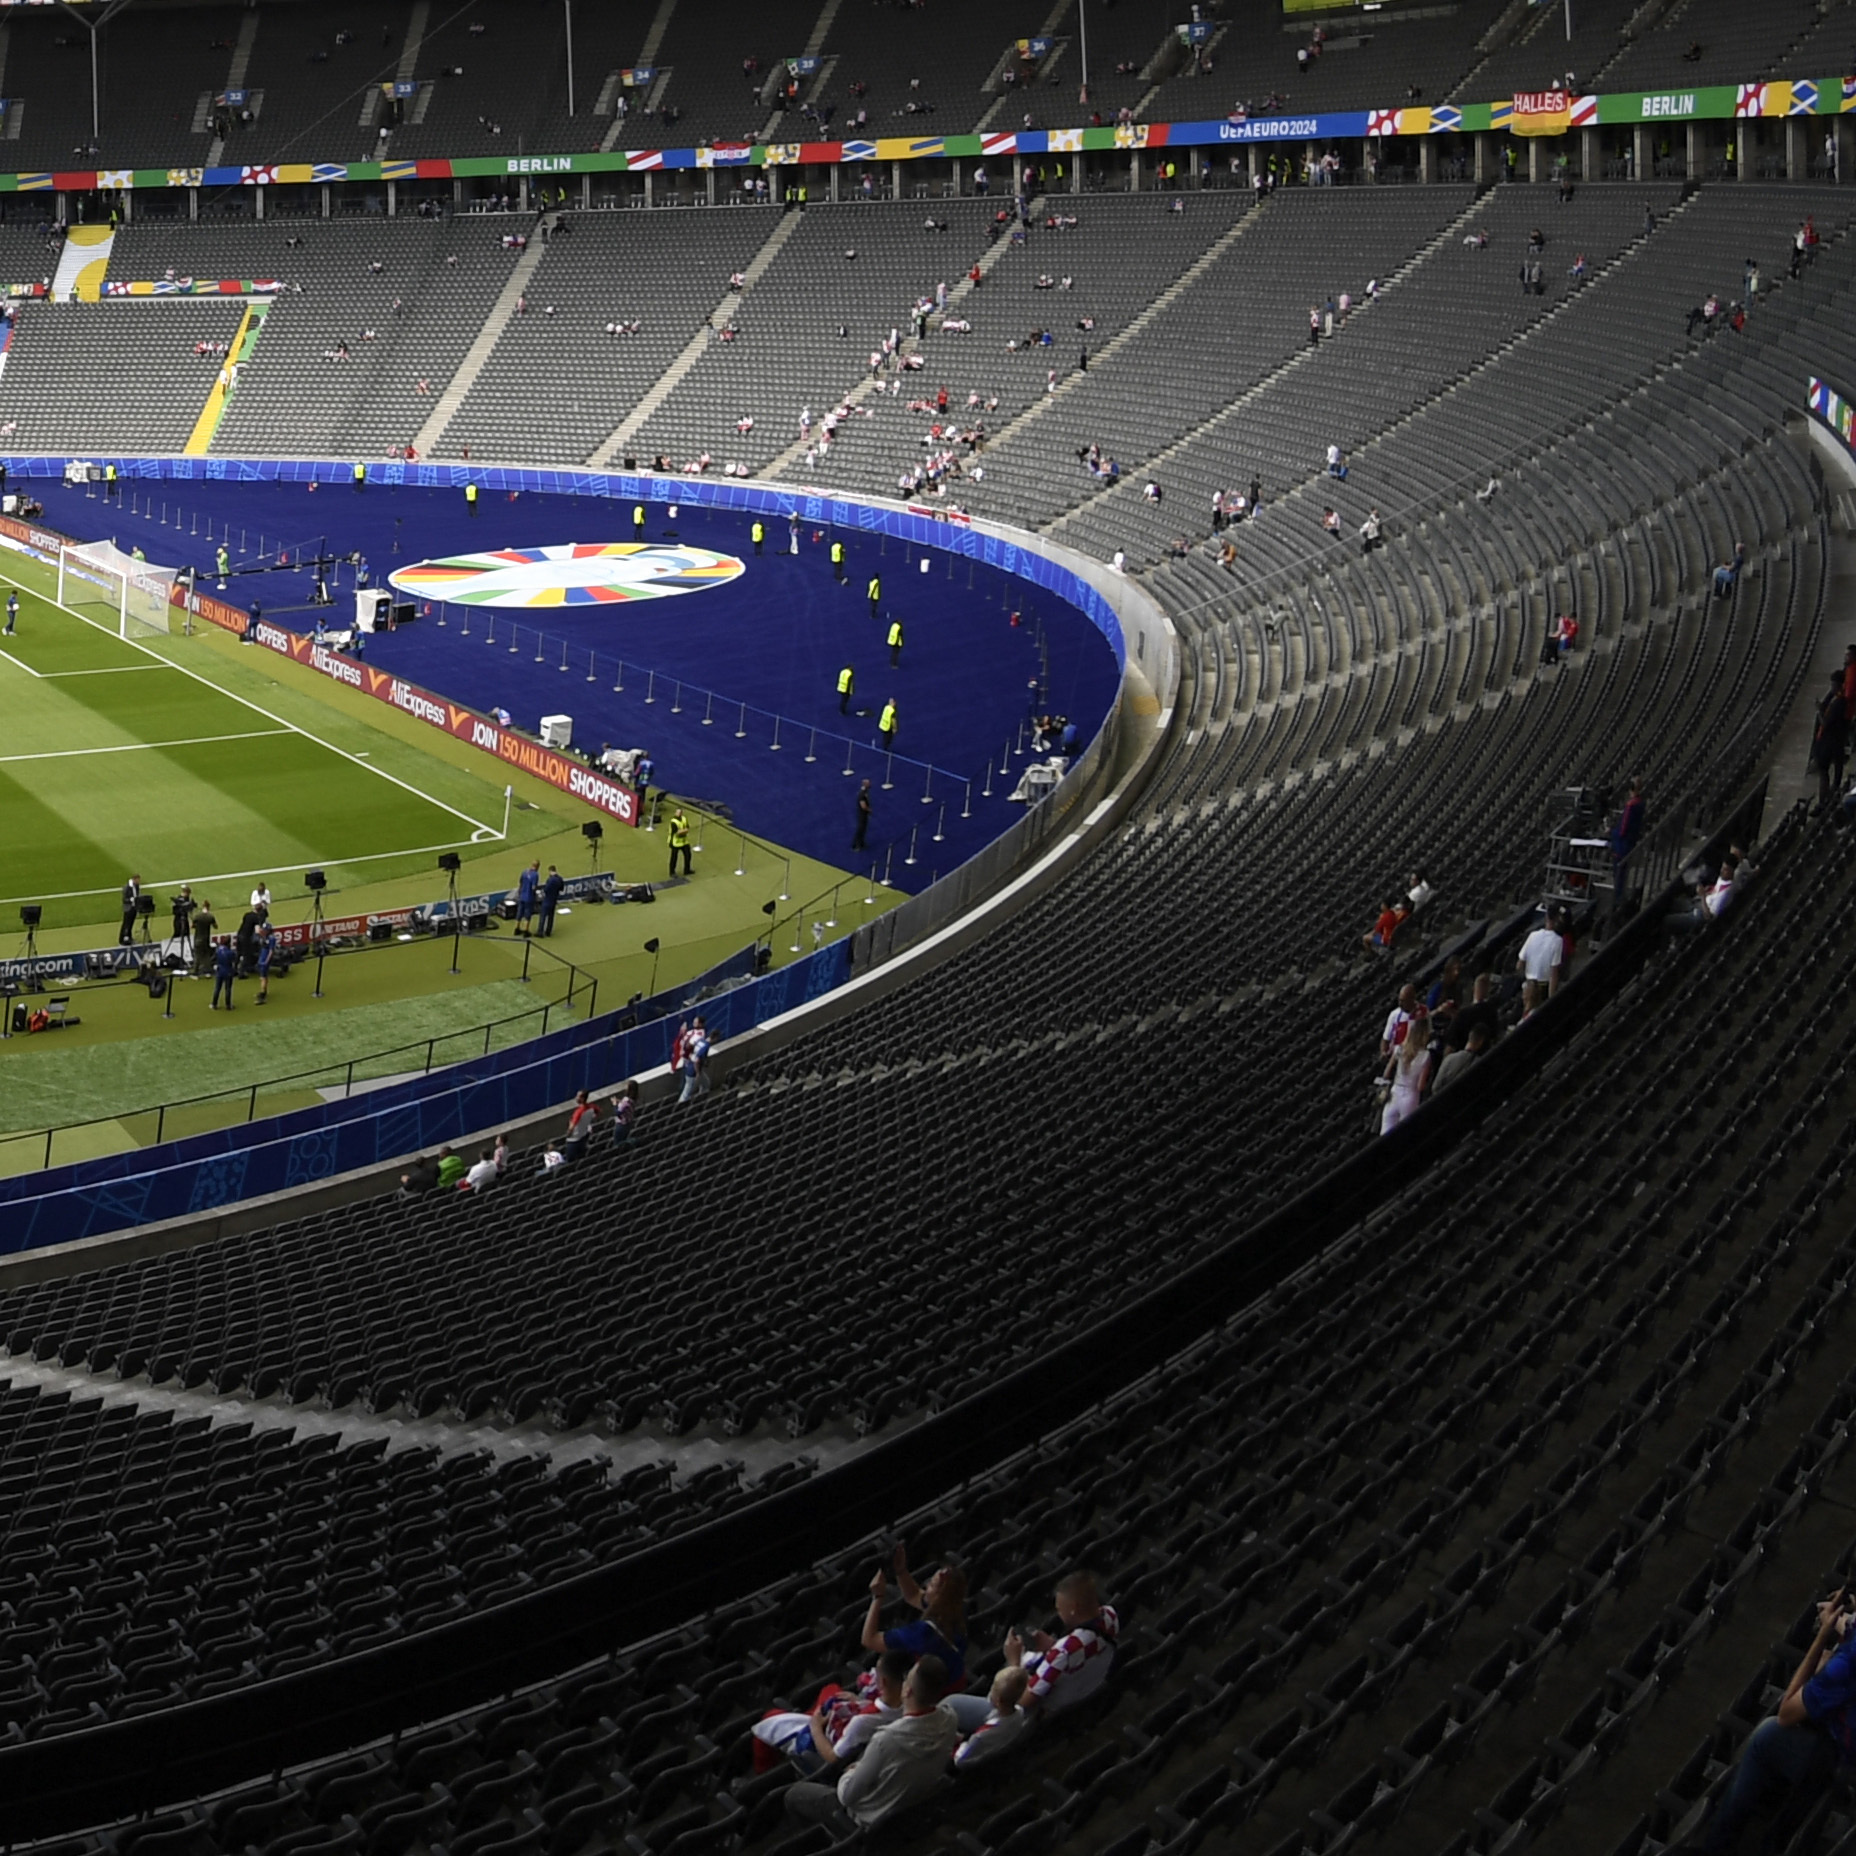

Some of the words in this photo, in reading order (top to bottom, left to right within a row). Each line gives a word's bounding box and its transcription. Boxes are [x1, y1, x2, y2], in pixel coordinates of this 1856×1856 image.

[1641, 94, 1695, 117] BERLIN
[1219, 119, 1318, 141] UEFAEURO2024
[507, 157, 572, 173] BERLIN
[29, 524, 60, 553] SHOPPERS
[199, 599, 213, 617] 150
[212, 604, 247, 633] MILLION
[309, 645, 363, 686] AliExpress
[389, 678, 446, 726] AliExpress
[471, 719, 498, 752] JOIN
[498, 733, 520, 763] 150
[519, 741, 570, 786] MILLION
[569, 767, 632, 819] SHOPPERS
